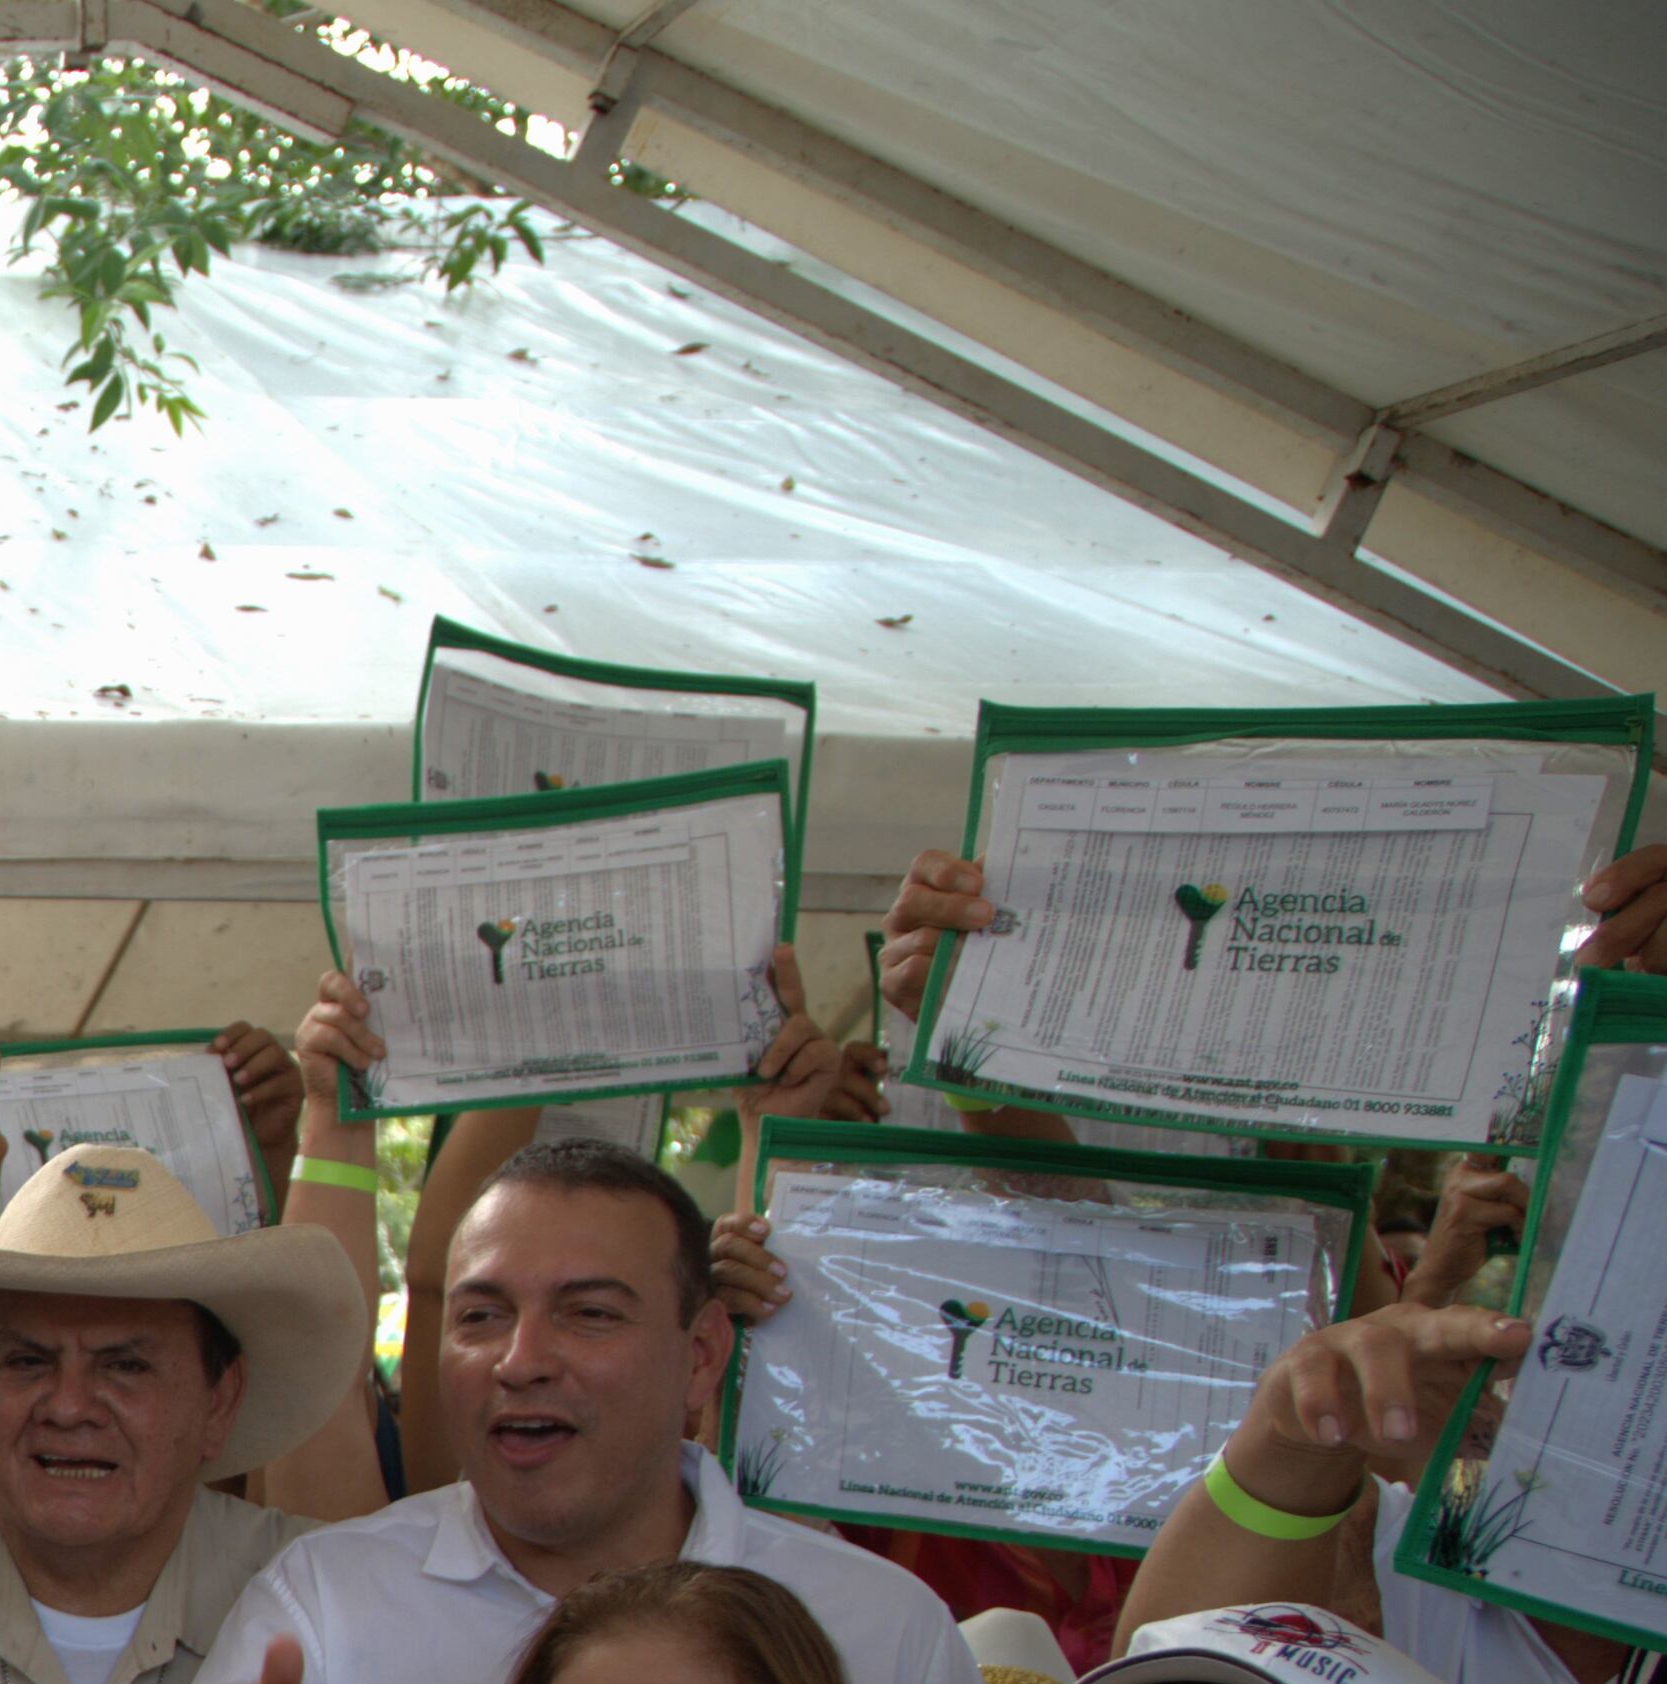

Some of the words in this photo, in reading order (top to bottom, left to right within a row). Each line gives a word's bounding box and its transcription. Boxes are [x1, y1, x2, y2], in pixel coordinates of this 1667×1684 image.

[1029, 776, 1095, 788] DEPARTAMENTO
[1244, 779, 1281, 789] NOMBRE
[1413, 777, 1452, 788] NOMBRE
[1232, 887, 1366, 917] Agencia
[521, 911, 614, 939] Agencia
[1229, 916, 1376, 946] Nacional
[1378, 932, 1401, 947] de
[522, 929, 625, 959] Nacional
[629, 933, 643, 947] de
[1226, 945, 1340, 974] Tierras
[522, 956, 605, 982] Tierras
[1058, 1069, 1095, 1087] Línea
[1098, 1076, 1158, 1095] Nacional
[1267, 1094, 1339, 1113] Ciudadano
[1343, 1097, 1360, 1112] 01
[1363, 1099, 1399, 1115] 8000
[1403, 1101, 1455, 1118] 933881
[995, 1306, 1118, 1342] Agencia
[988, 1334, 1125, 1371] Nacional
[987, 1360, 1094, 1395] Tierras
[1612, 1421, 1633, 1458] AGENCIA
[1628, 1369, 1654, 1422] NACIONAL
[840, 1479, 874, 1495] Línea
[878, 1483, 933, 1503] Nacional
[936, 1490, 953, 1504] de
[955, 1493, 1014, 1511] Atención
[1033, 1503, 1104, 1523] Ciudadano
[1107, 1511, 1123, 1525] 01
[1124, 1513, 1157, 1530] 8000
